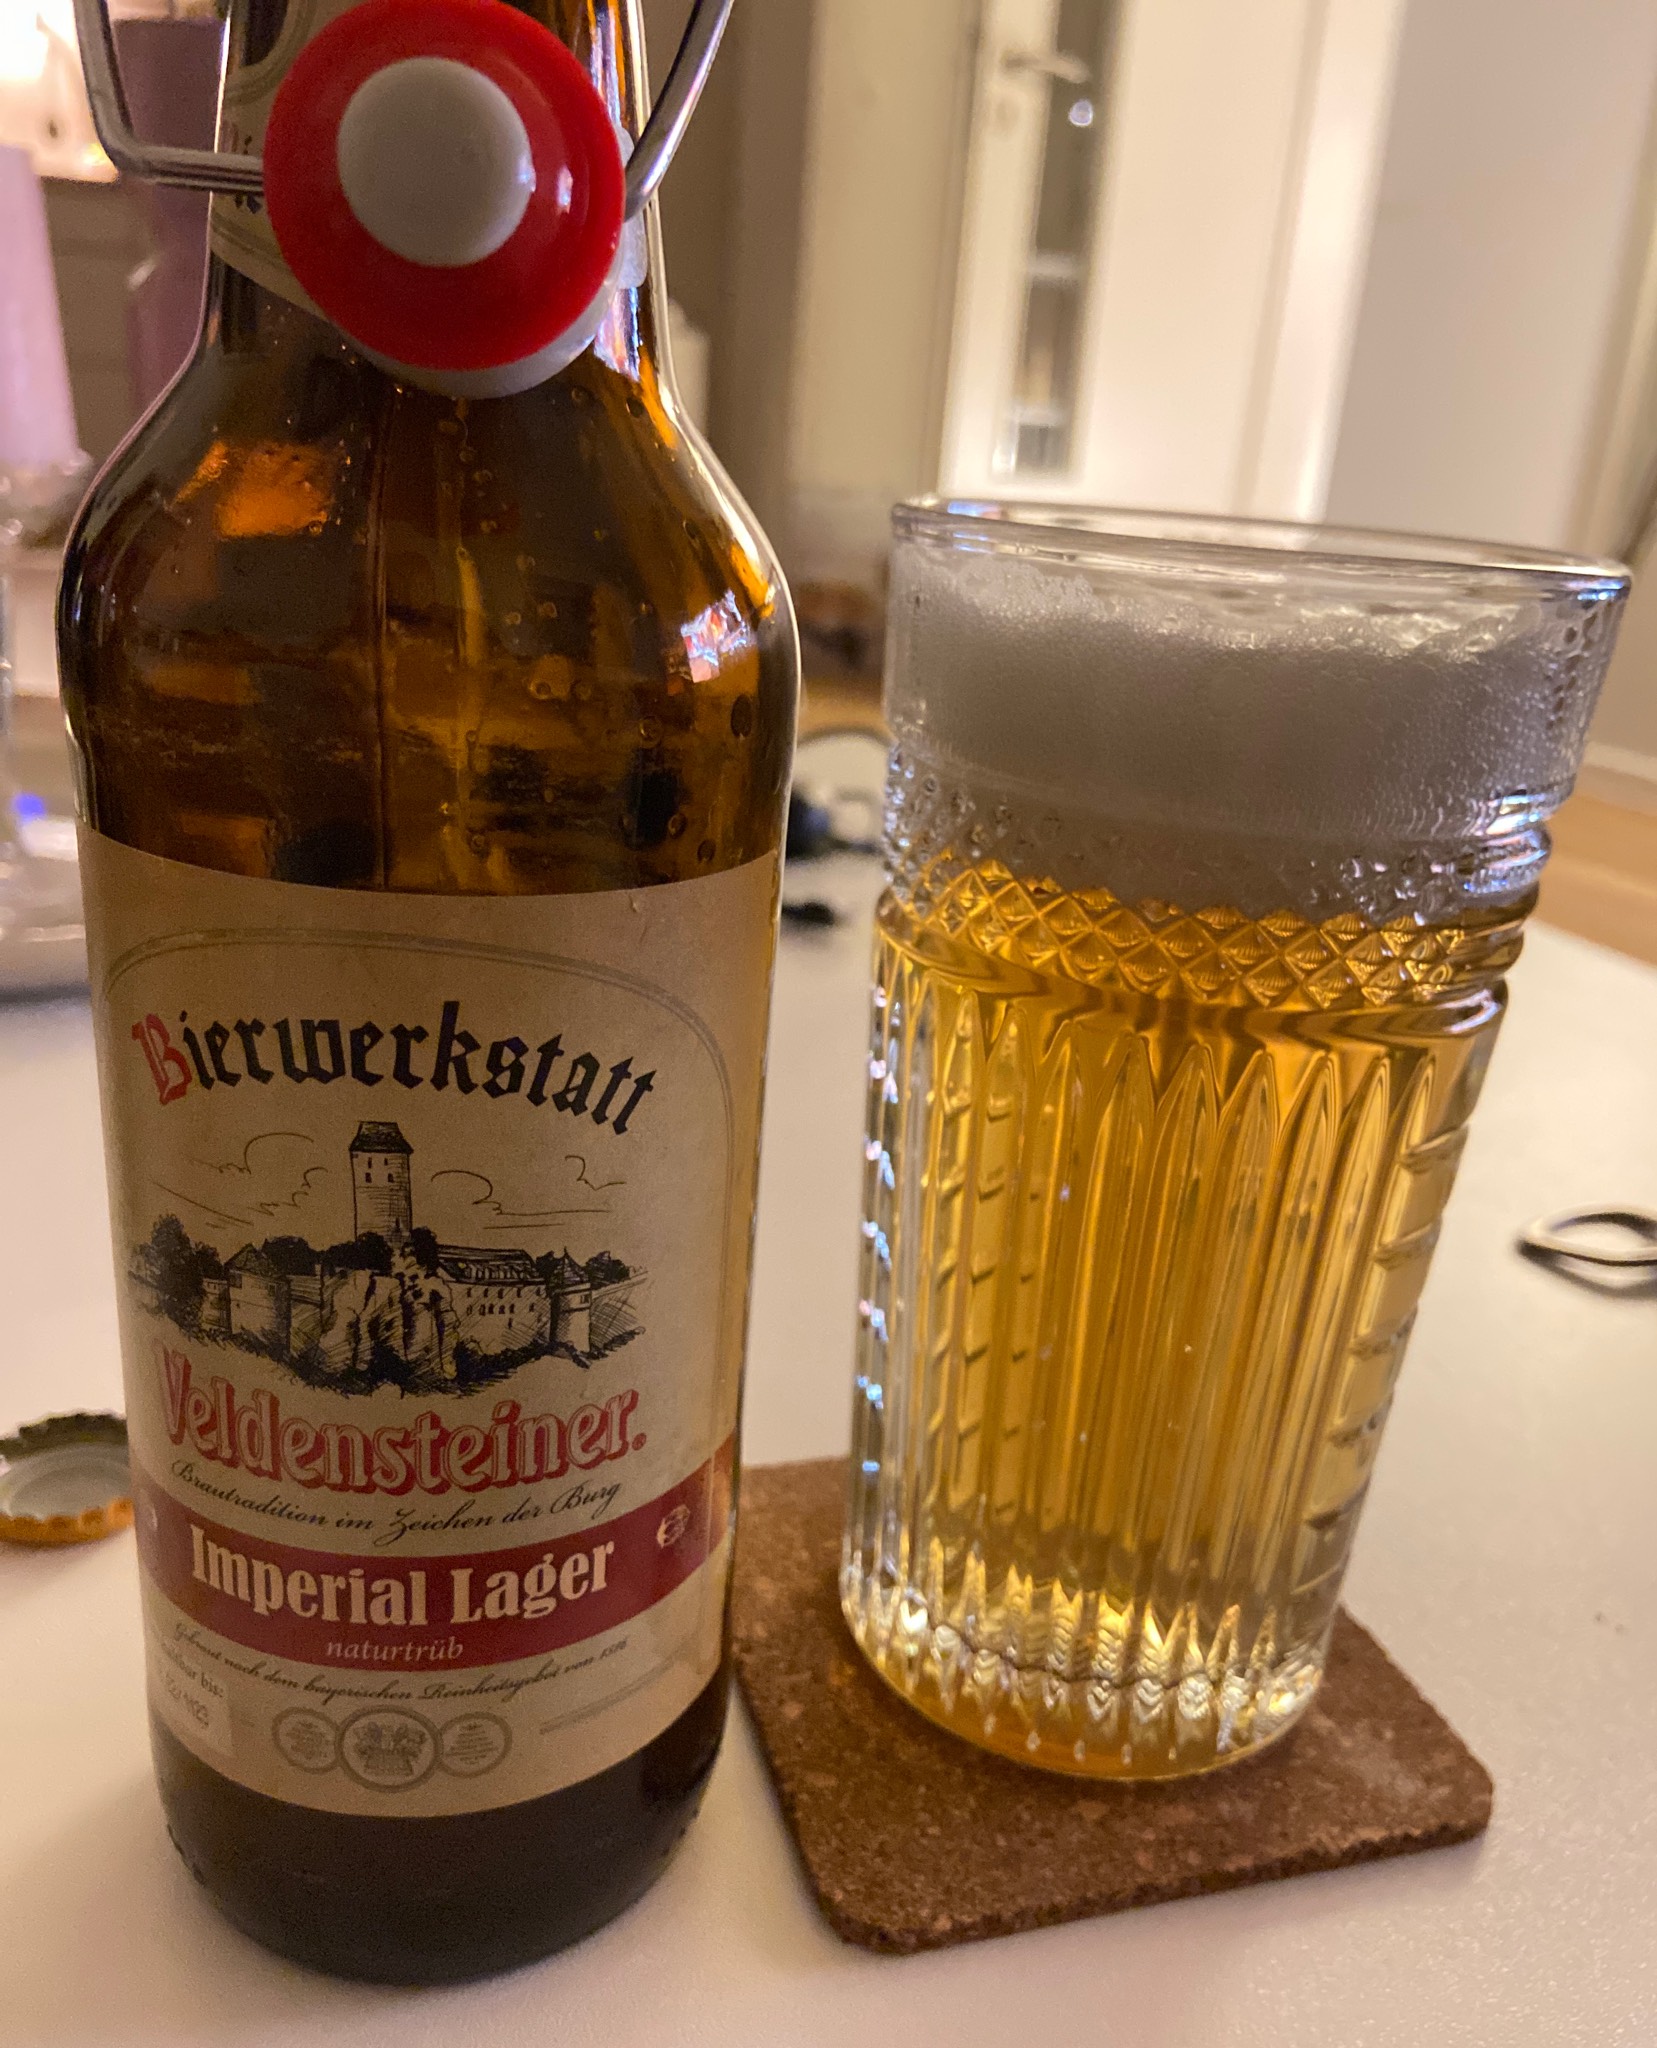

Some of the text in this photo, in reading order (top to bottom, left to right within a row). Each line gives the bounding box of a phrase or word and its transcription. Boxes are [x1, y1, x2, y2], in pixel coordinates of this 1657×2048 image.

[131, 1000, 657, 1135] Bierwerkstatt
[171, 1459, 622, 1547] Brautradition im Zeichen der Burg
[190, 1524, 614, 1626] Imperial Lager
[326, 1636, 463, 1662] naturtrüb
